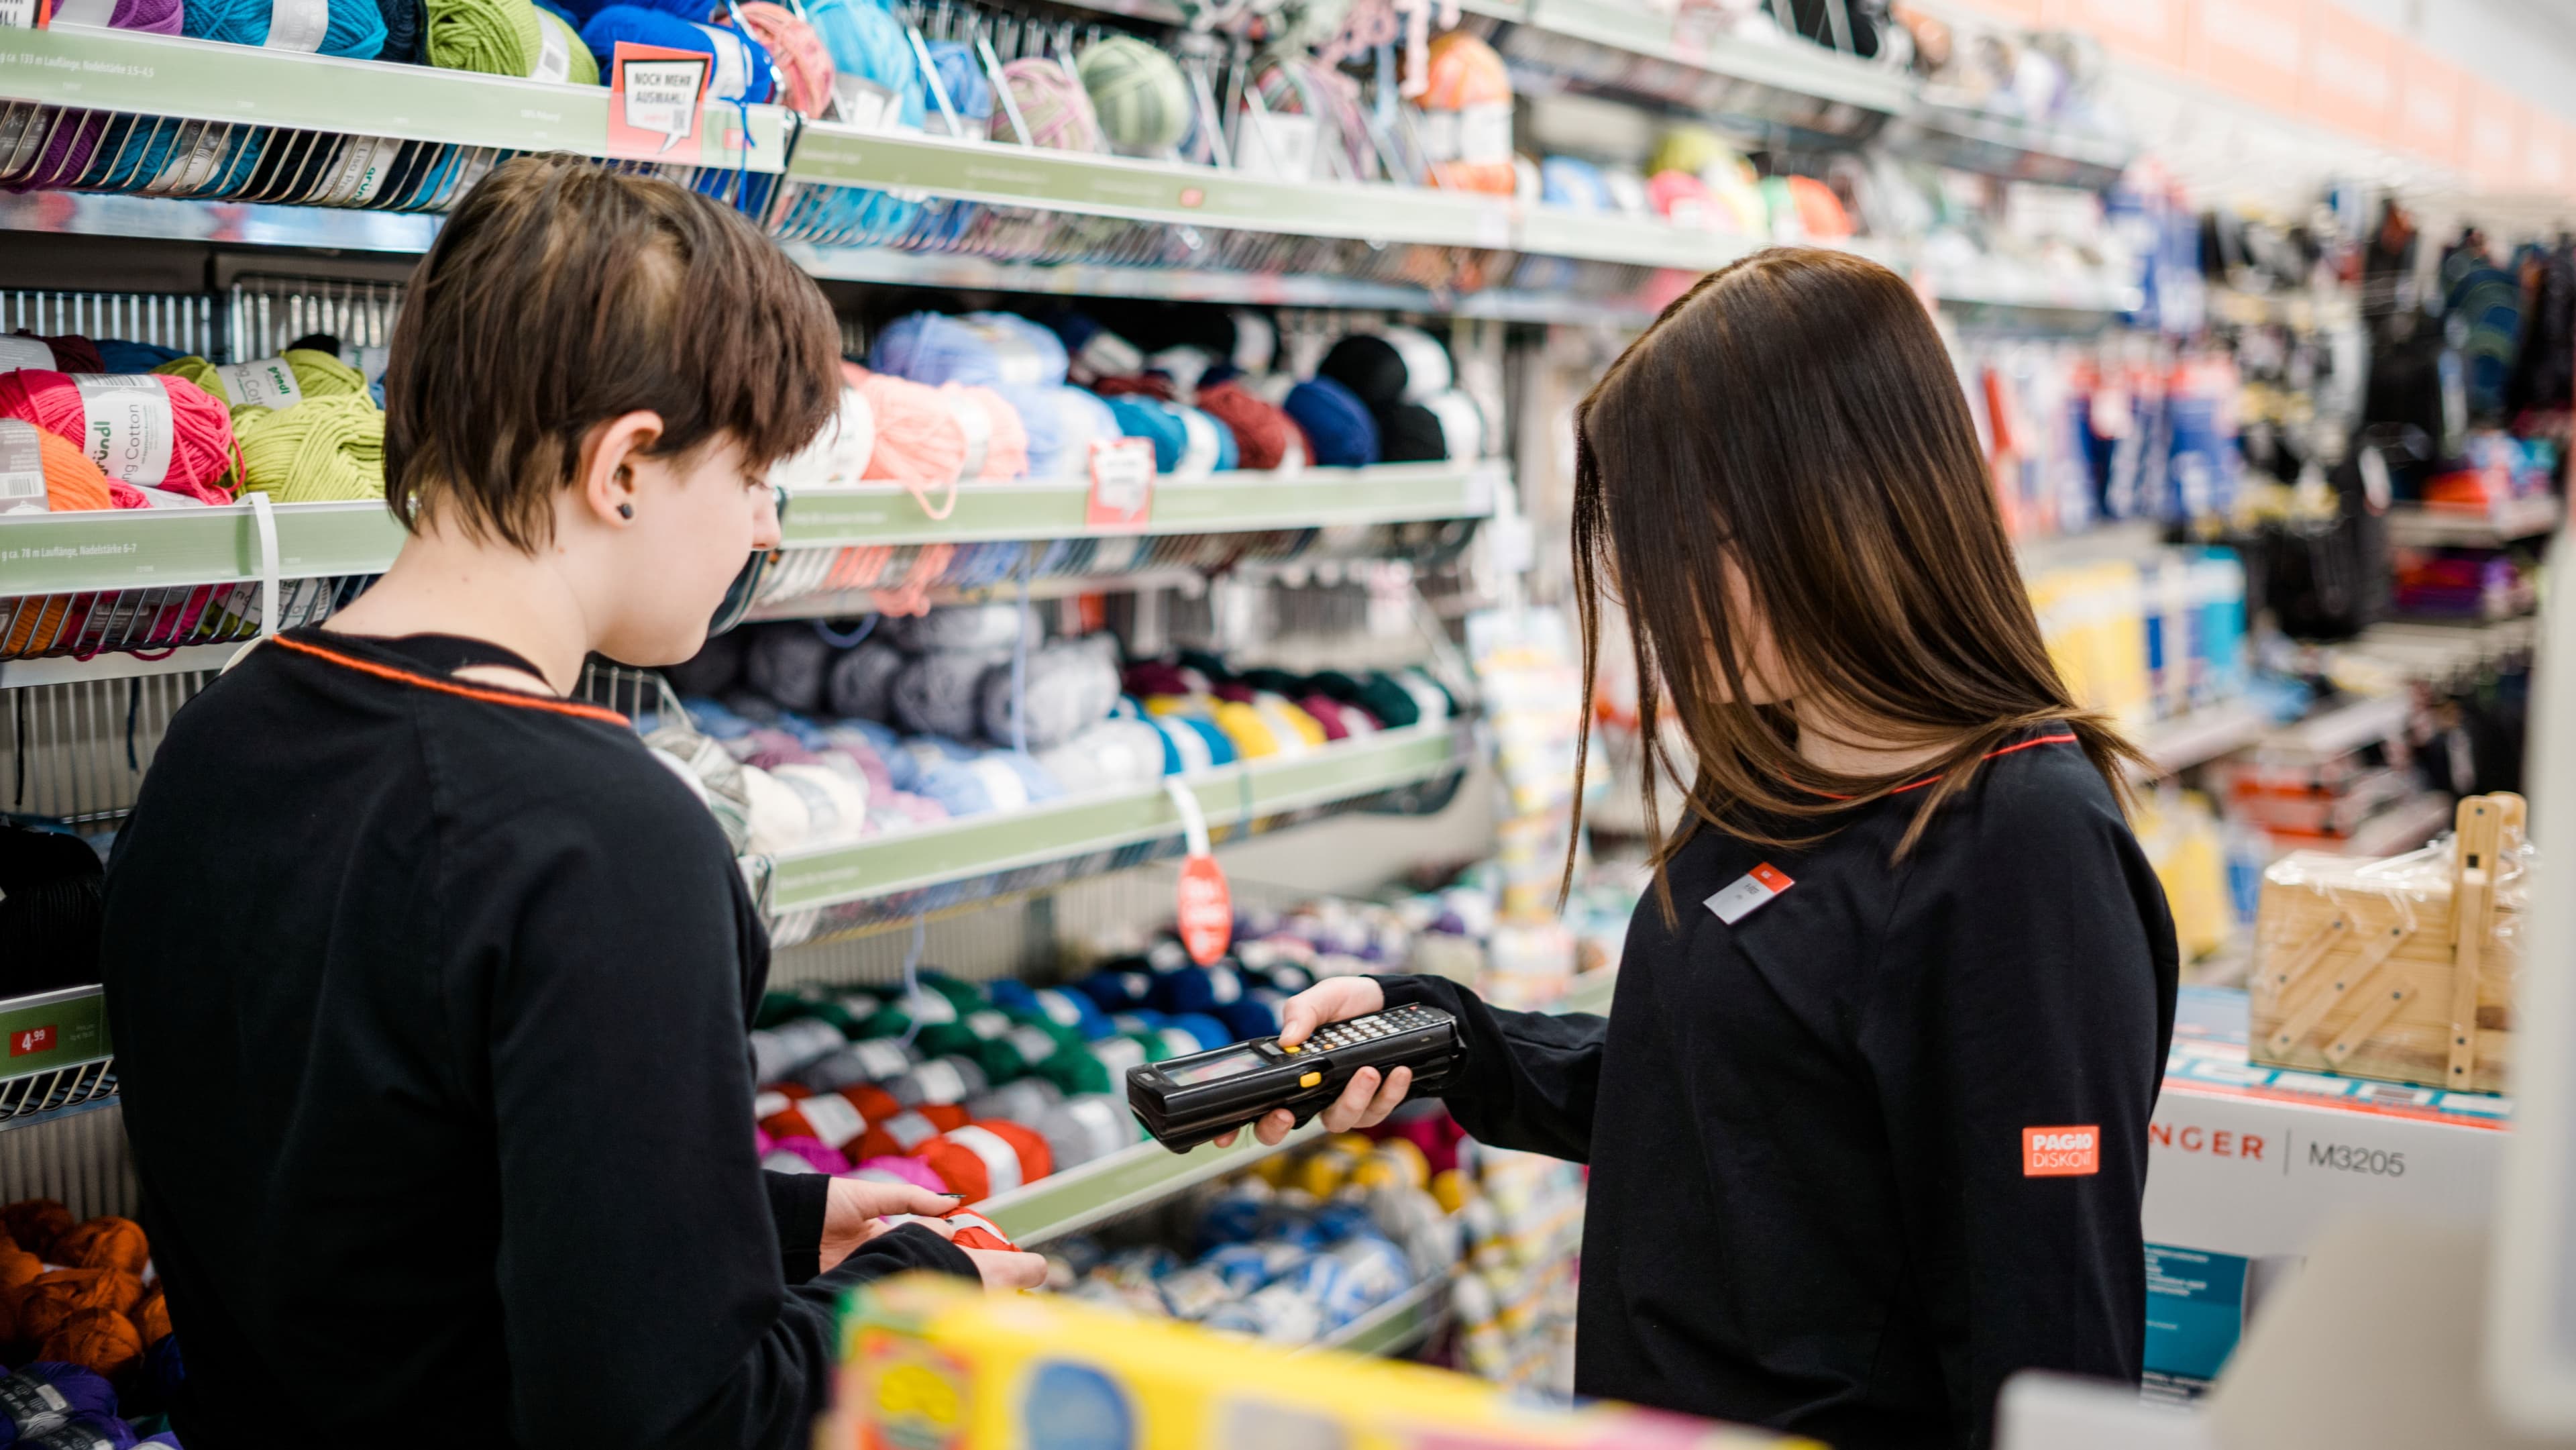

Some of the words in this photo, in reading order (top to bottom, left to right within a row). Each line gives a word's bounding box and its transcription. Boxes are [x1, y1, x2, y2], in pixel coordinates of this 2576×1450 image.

[635, 72, 661, 86] NOCH
[665, 74, 692, 87] MEHR
[125, 404, 141, 460] Cotton
[2308, 1141, 2406, 1178] M3205
